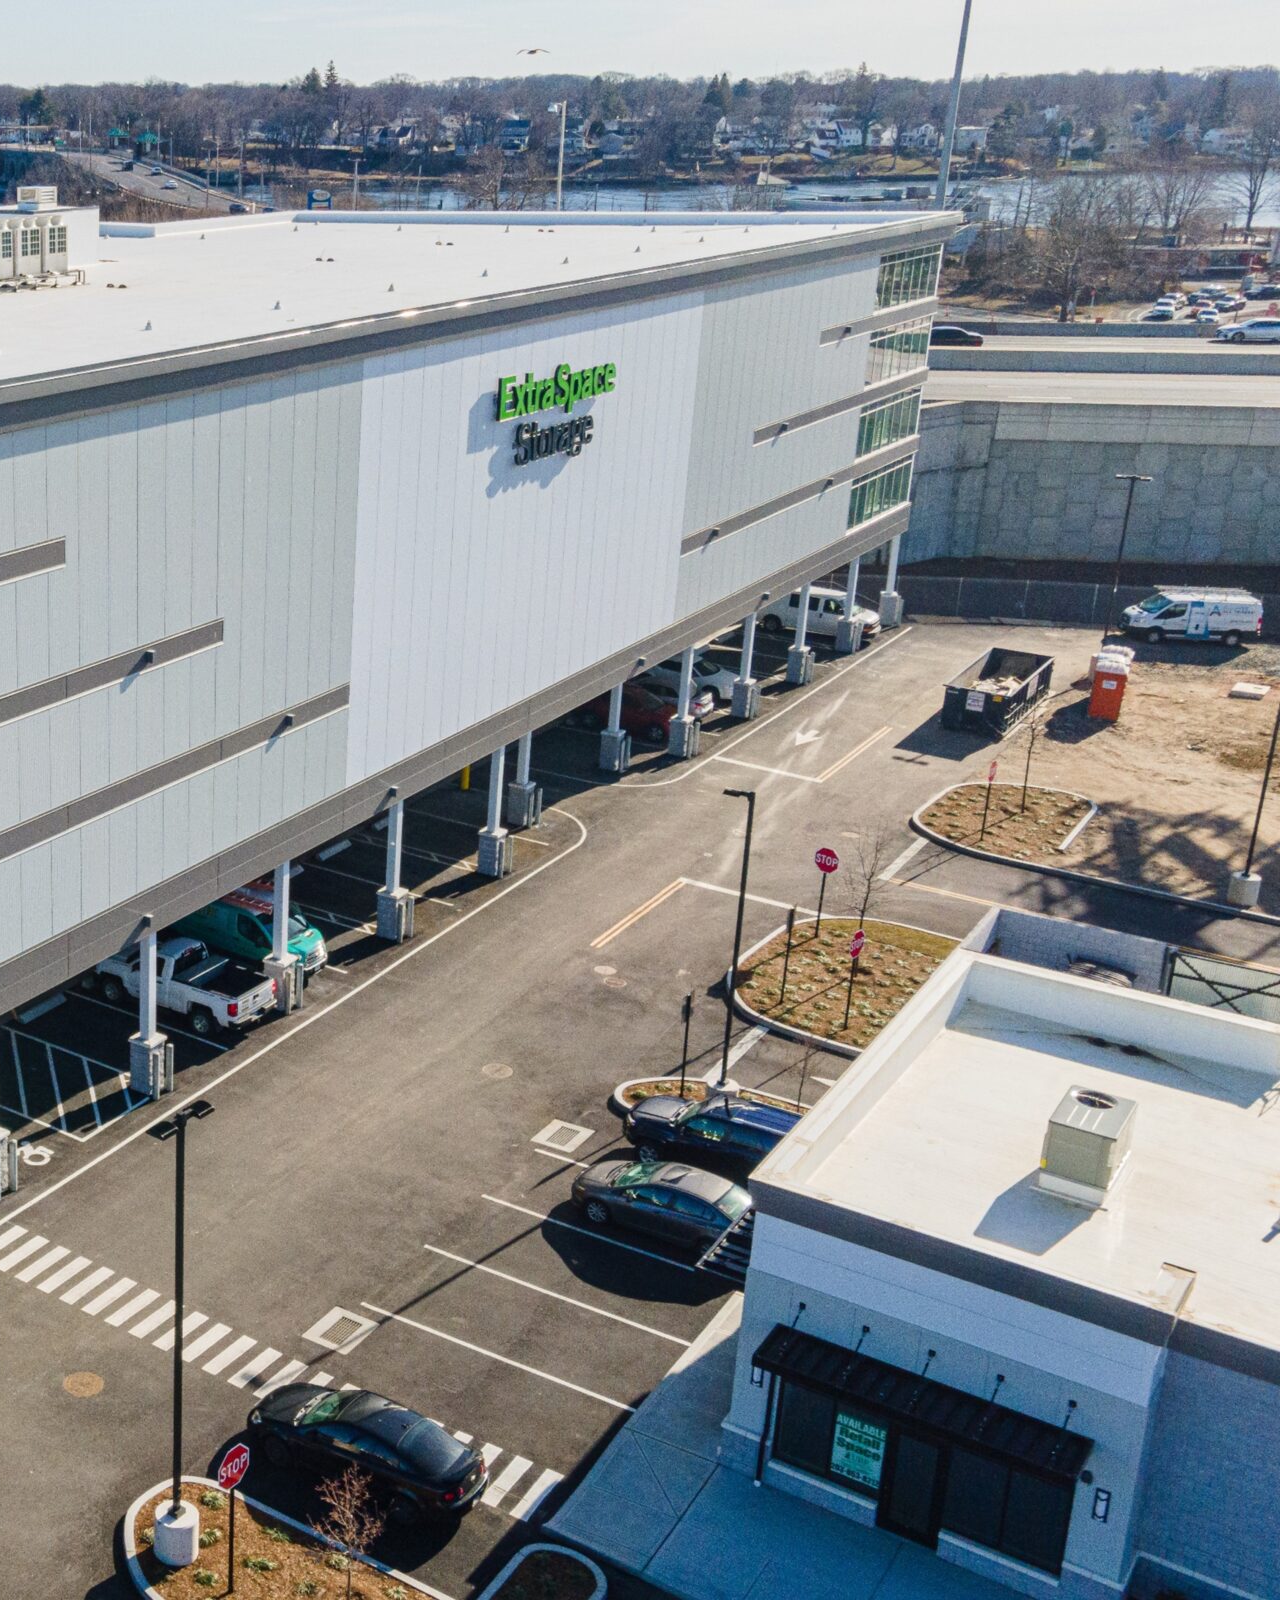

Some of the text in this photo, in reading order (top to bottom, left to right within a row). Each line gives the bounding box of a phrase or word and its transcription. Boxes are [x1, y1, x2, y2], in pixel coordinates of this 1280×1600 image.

[496, 362, 617, 422] ExtraSpace
[513, 414, 595, 466] Storage
[815, 853, 839, 867] STOP
[836, 1413, 887, 1440] AVAILABLE
[839, 1426, 881, 1450] Retail
[836, 1436, 881, 1462] Space
[220, 1452, 247, 1483] STOP
